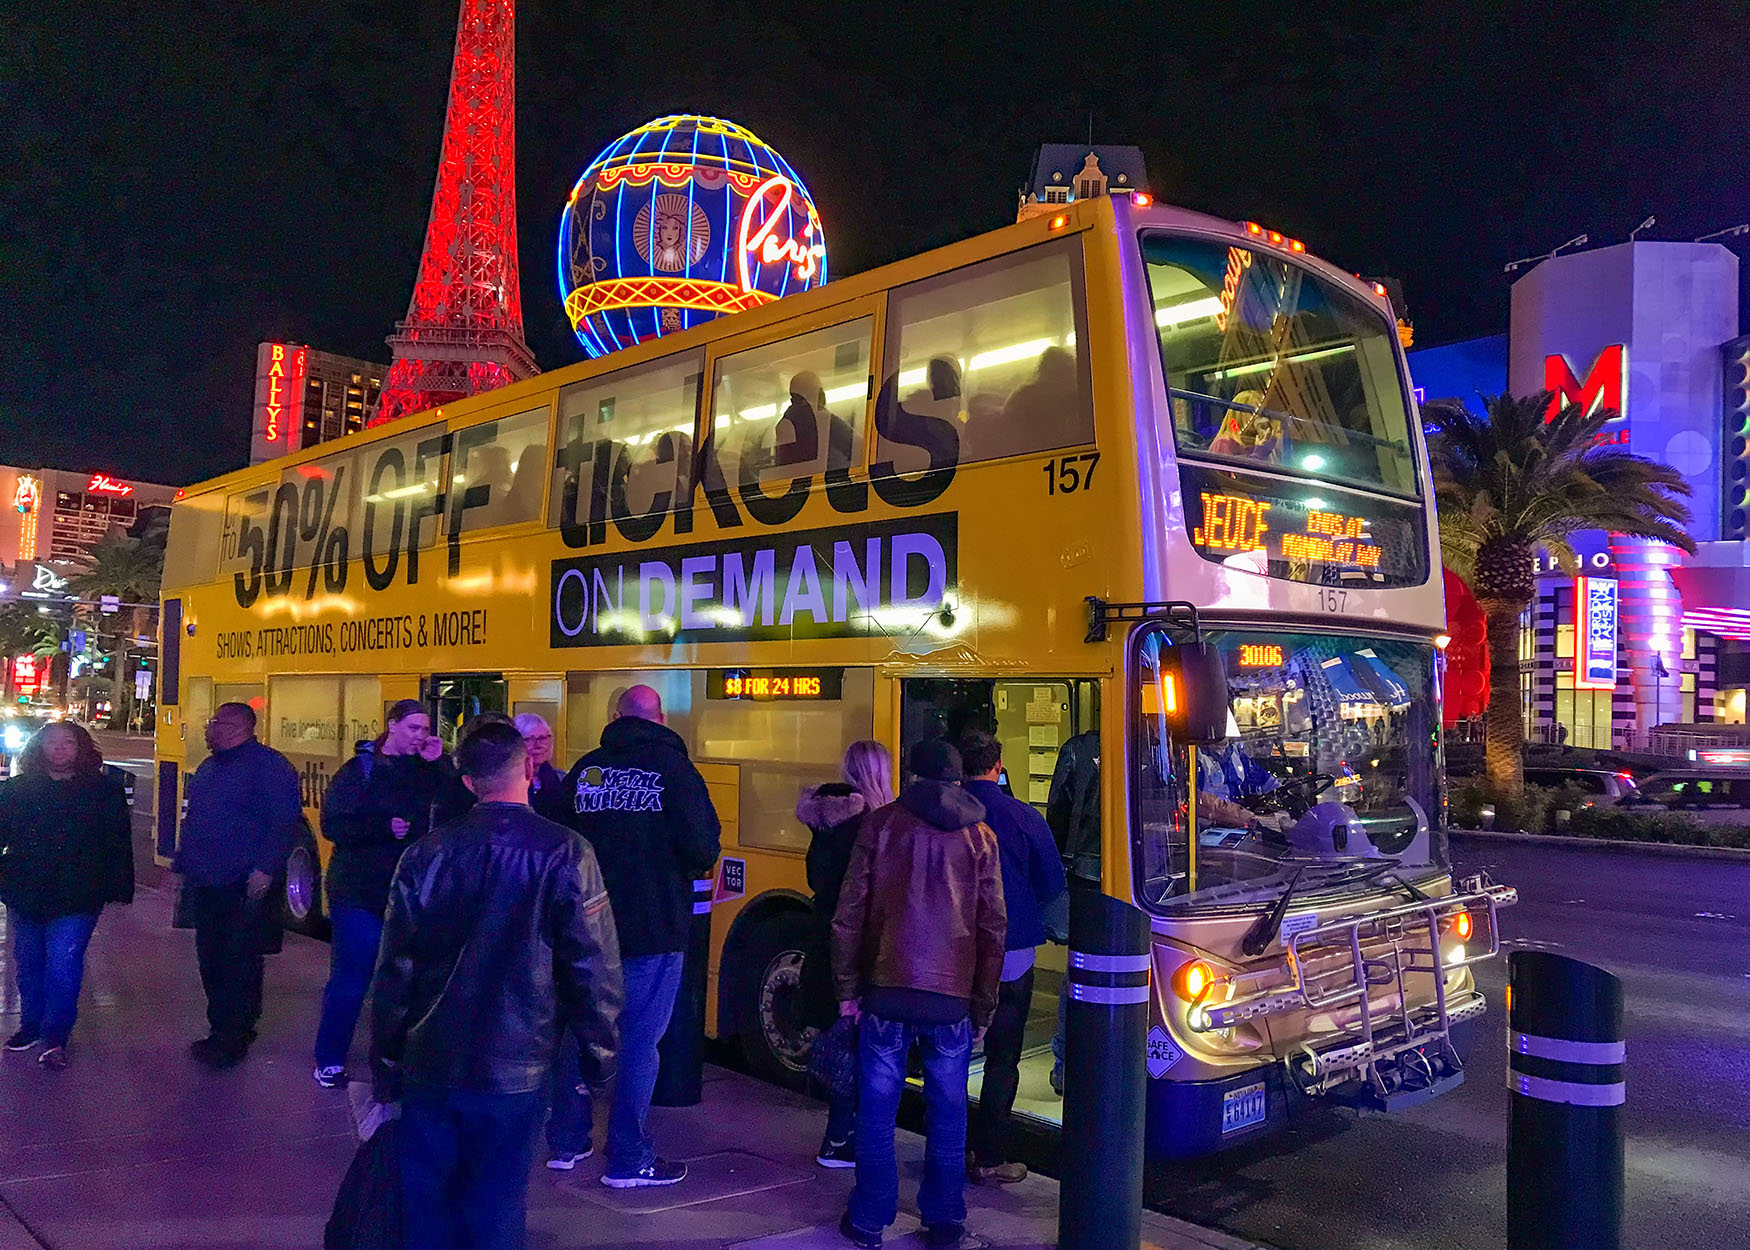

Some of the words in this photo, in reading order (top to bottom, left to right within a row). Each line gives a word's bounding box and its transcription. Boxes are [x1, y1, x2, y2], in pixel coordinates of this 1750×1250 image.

[739, 175, 826, 292] Paris
[266, 344, 285, 441] BALLYS
[1544, 344, 1626, 425] M
[556, 343, 960, 549] tickets
[1043, 453, 1100, 495] 157
[234, 466, 349, 608] 50%
[362, 423, 498, 592] OFF
[1346, 517, 1365, 539] AT
[556, 565, 624, 637] ON
[639, 532, 947, 632] DEMAND
[1318, 589, 1348, 613] 157
[216, 631, 255, 660] SHOWS,
[255, 623, 336, 658] ATTRACTIONS,
[340, 616, 412, 652] CONCERTS
[417, 615, 428, 647] &
[433, 609, 487, 646] MORE!
[1240, 645, 1282, 666] 30106
[725, 678, 742, 695] $8
[745, 678, 769, 695] FOR
[772, 678, 790, 695] 24
[793, 677, 820, 695] HRS
[281, 717, 297, 738] Five
[338, 723, 349, 741] on
[351, 718, 369, 741] The
[726, 864, 742, 876] VEC
[726, 876, 742, 887] TOR
[1234, 1096, 1262, 1122] 64147
